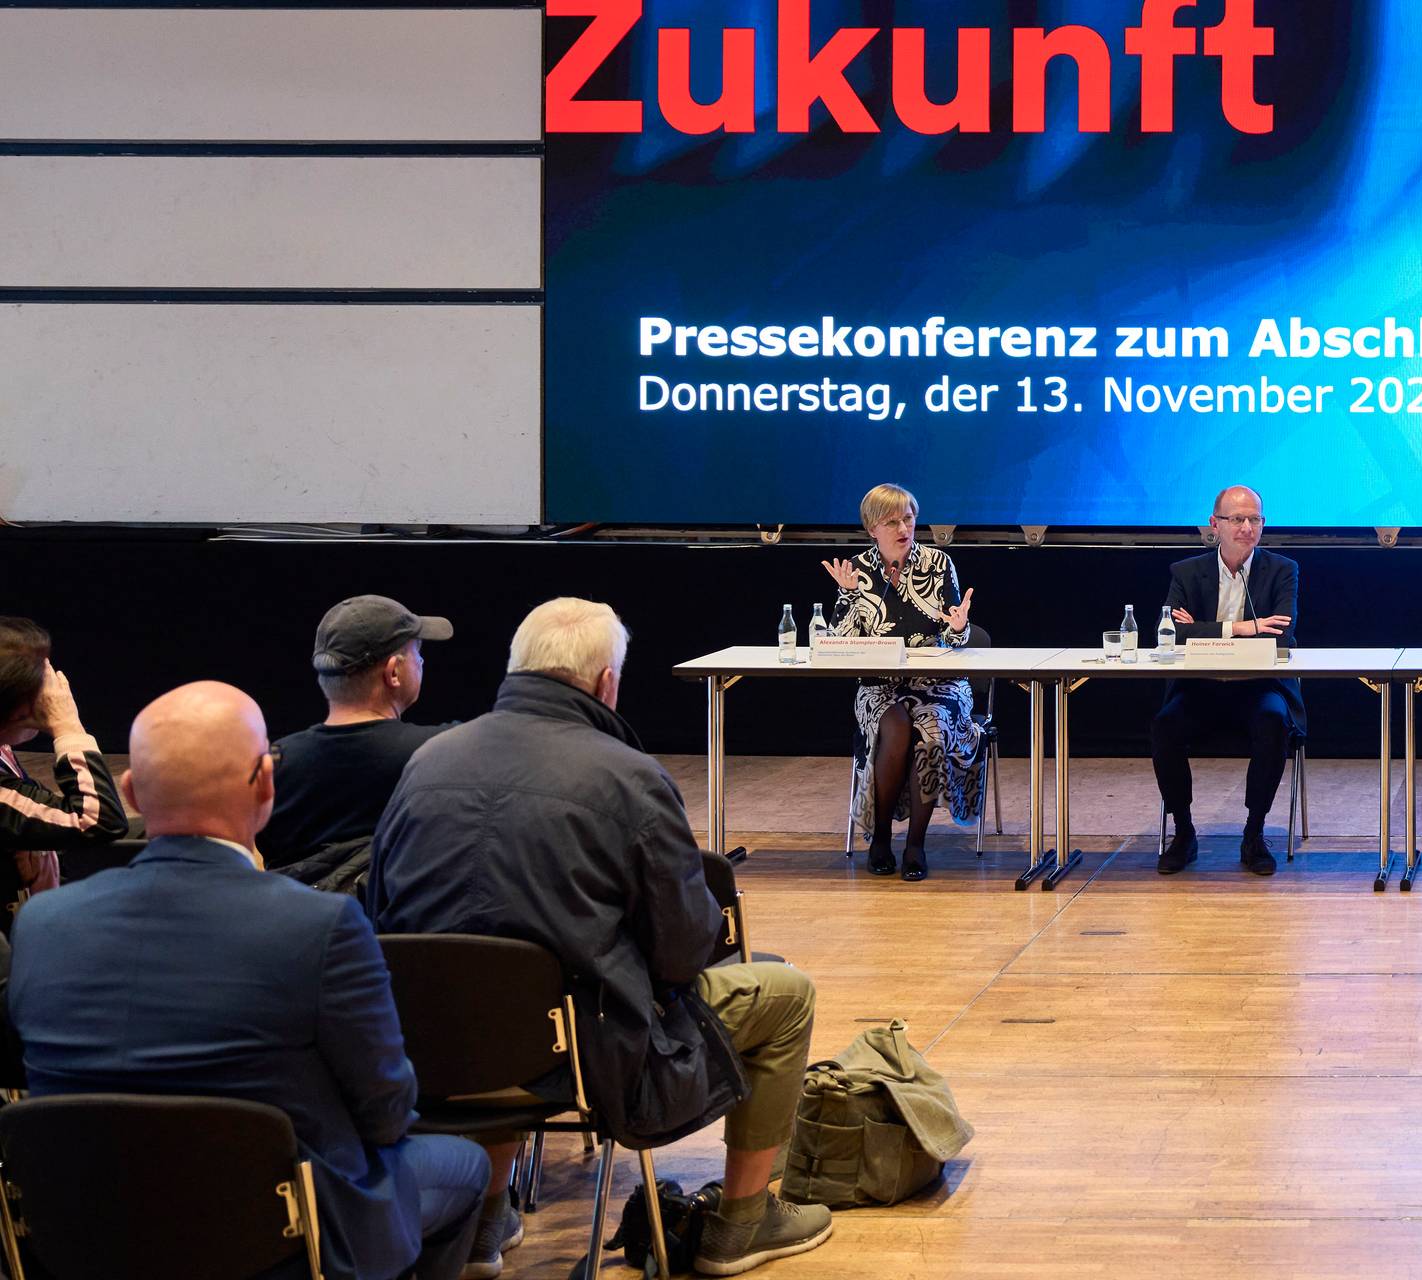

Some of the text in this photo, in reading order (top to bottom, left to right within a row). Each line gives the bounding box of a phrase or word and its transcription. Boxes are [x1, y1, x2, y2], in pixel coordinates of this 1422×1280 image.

[545, 0, 1274, 135] Zukunft
[638, 315, 1097, 359] Pressekonferenz
[1114, 325, 1230, 359] zum
[638, 374, 907, 421] Donnerstag,
[923, 374, 1000, 413] der
[1016, 375, 1083, 414] 13.
[1103, 374, 1335, 414] November
